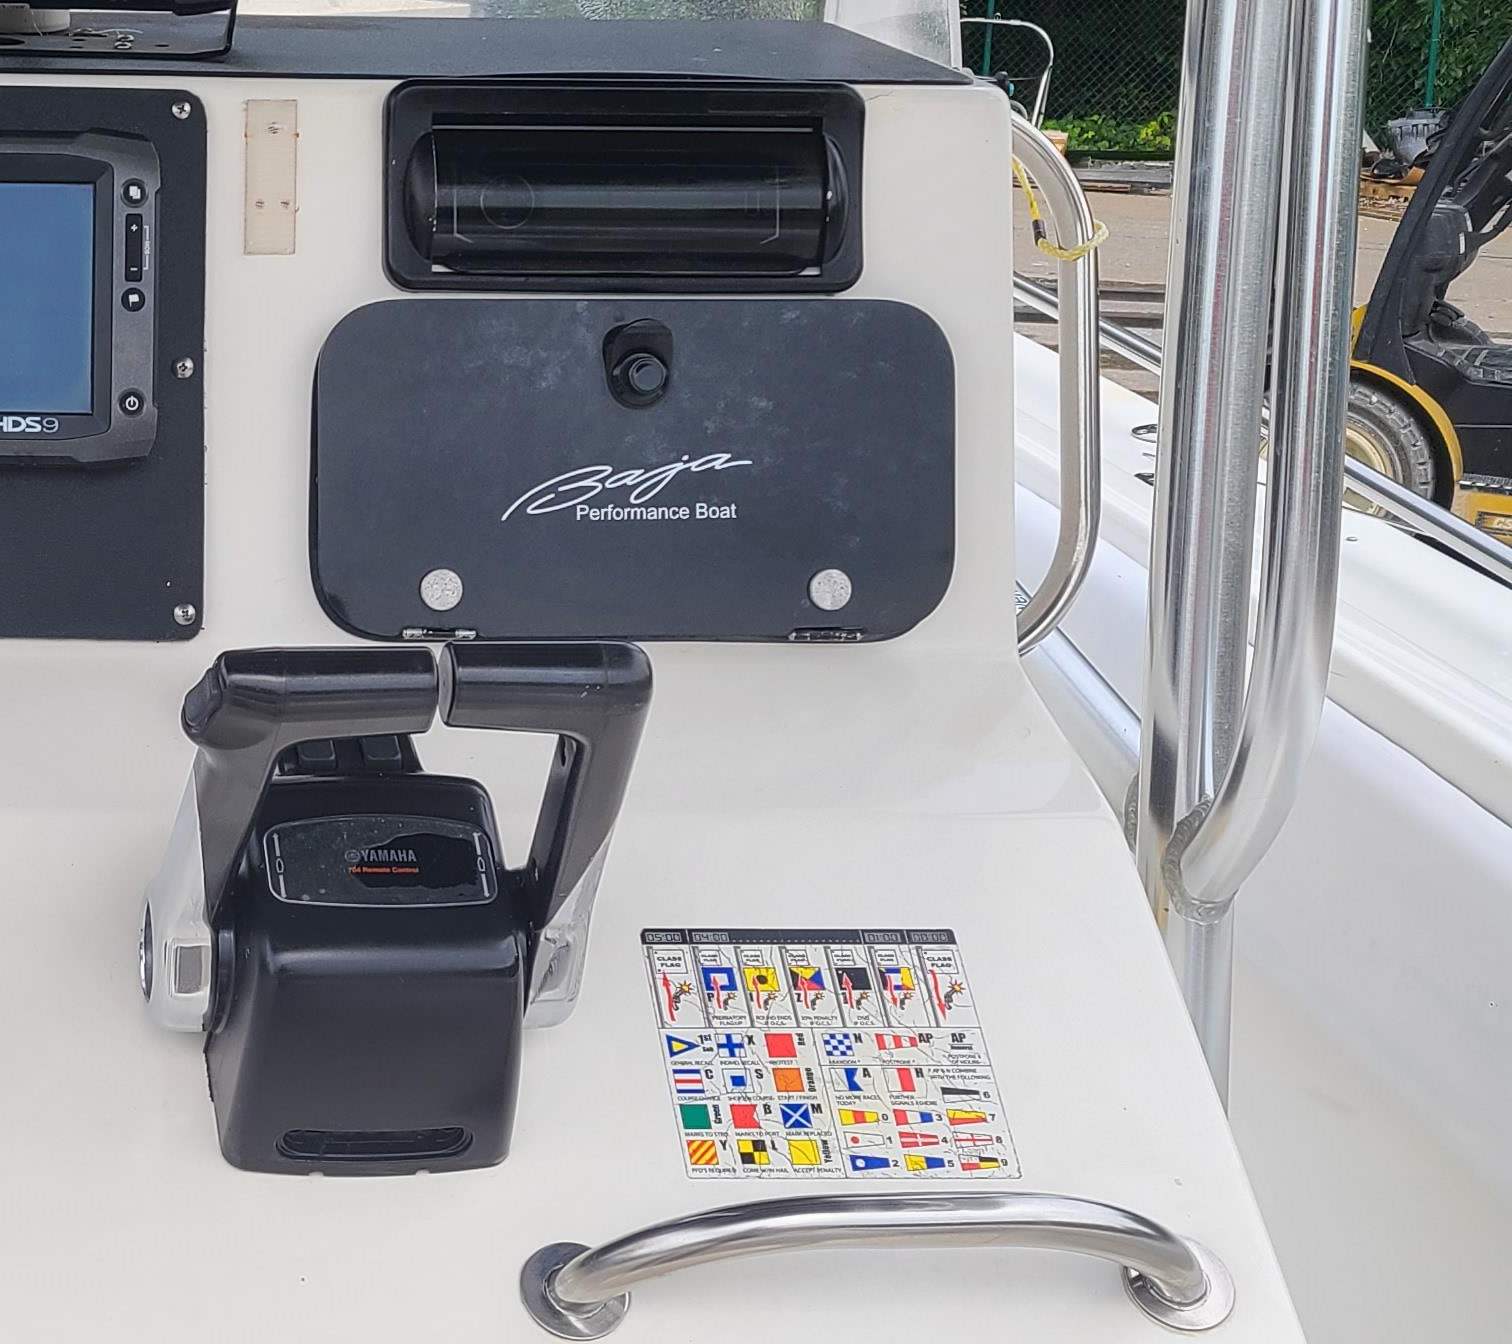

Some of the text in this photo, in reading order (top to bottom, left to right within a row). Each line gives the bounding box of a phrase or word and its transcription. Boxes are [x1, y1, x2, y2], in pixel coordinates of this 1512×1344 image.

[501, 453, 753, 521] Baja
[575, 502, 737, 521] Performance Boat
[360, 849, 417, 862] YAMAHA
[646, 932, 681, 943] 05:00
[746, 1034, 756, 1046] X
[853, 1033, 863, 1044] N
[918, 1033, 933, 1044] AP
[950, 1032, 966, 1043] AP
[705, 1068, 714, 1080] C
[754, 1068, 764, 1080] S
[862, 1067, 872, 1078] A
[914, 1067, 925, 1078] H
[805, 1067, 816, 1092] Orange
[763, 1104, 772, 1115] B
[811, 1104, 823, 1114] M
[935, 1113, 943, 1121] 3
[989, 1113, 996, 1121] 7
[719, 1140, 727, 1150] Y
[887, 1136, 893, 1144] 1
[941, 1136, 948, 1144] 4
[995, 1136, 1003, 1144] 8
[891, 1160, 900, 1168] 2
[947, 1160, 955, 1168] 5
